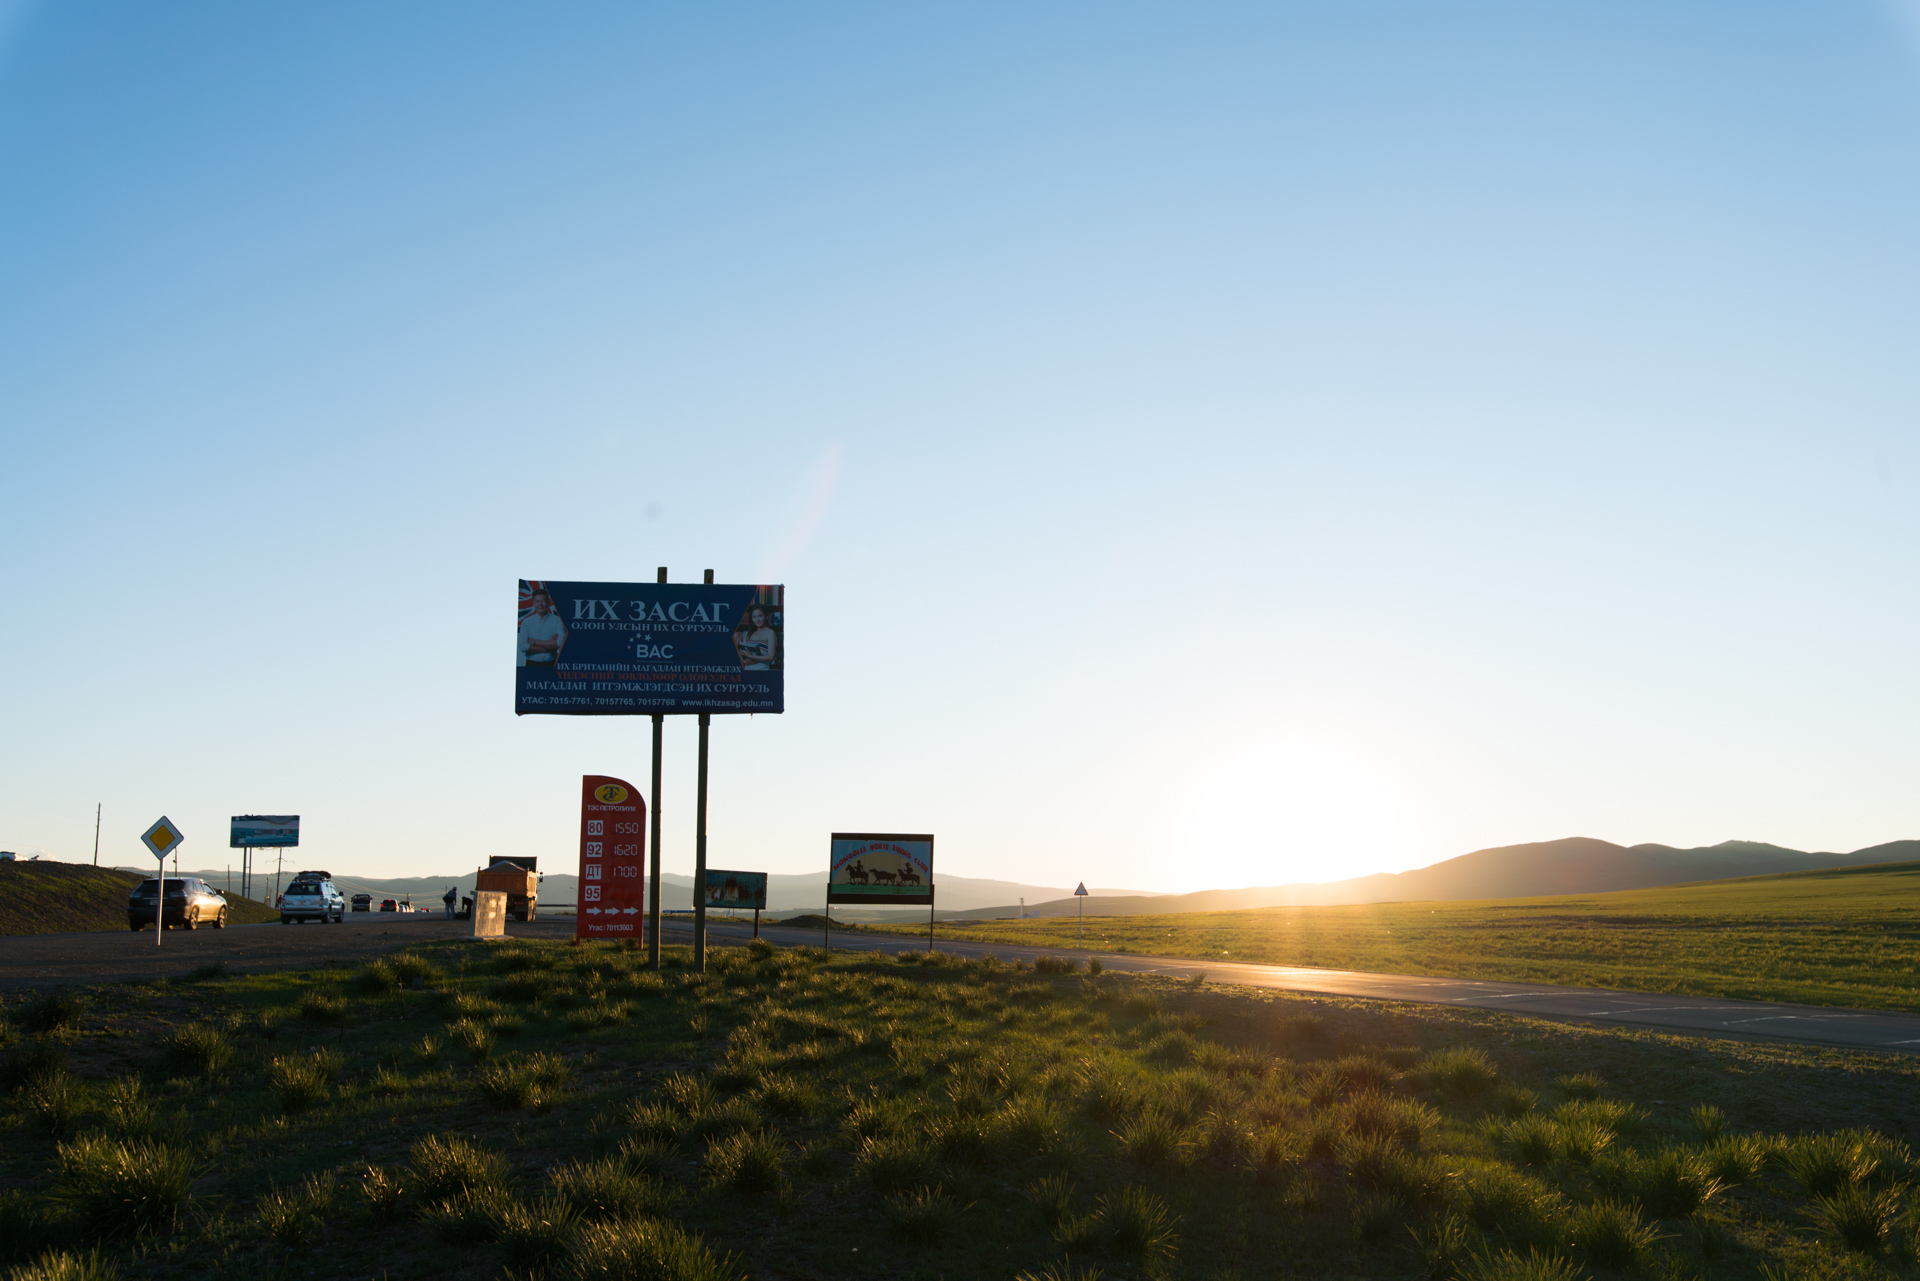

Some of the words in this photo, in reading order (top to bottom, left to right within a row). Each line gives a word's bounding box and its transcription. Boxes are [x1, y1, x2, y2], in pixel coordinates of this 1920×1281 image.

[572, 599, 620, 621] ИХ
[628, 600, 730, 622] ЗАСАГ
[571, 621, 605, 630] ОЛОН
[608, 622, 650, 631] УЛСЫН
[653, 623, 669, 632] ИХ
[671, 624, 730, 633] СУРГУУЛЬ
[636, 644, 674, 659] BAC
[557, 663, 570, 671] ИХ
[572, 662, 630, 672] БРИТАНИЙН
[632, 664, 681, 673] МАГАДЛАН
[683, 665, 742, 673] ИТГЭМЖЛЭХ
[678, 673, 707, 682] ОЛОН
[526, 681, 587, 691] МАГАДЛАН
[592, 682, 694, 693] ИТГЭМЖЛЭГДСЭН
[696, 683, 712, 692] ИХ
[714, 684, 770, 693] СУРГУУЛЬ
[521, 696, 547, 705] УТАС:
[549, 697, 593, 706] 7015-7761,
[595, 697, 636, 707] 70157765,
[638, 698, 676, 706] 70157768
[682, 699, 774, 709] www.ikhzasag.edu.mn
[588, 822, 602, 834] 80
[615, 822, 639, 834] 1550
[587, 844, 602, 856] 92
[614, 844, 638, 856] 1620
[586, 866, 601, 879] ДТ
[613, 866, 638, 878] 1700
[585, 888, 600, 899] 95
